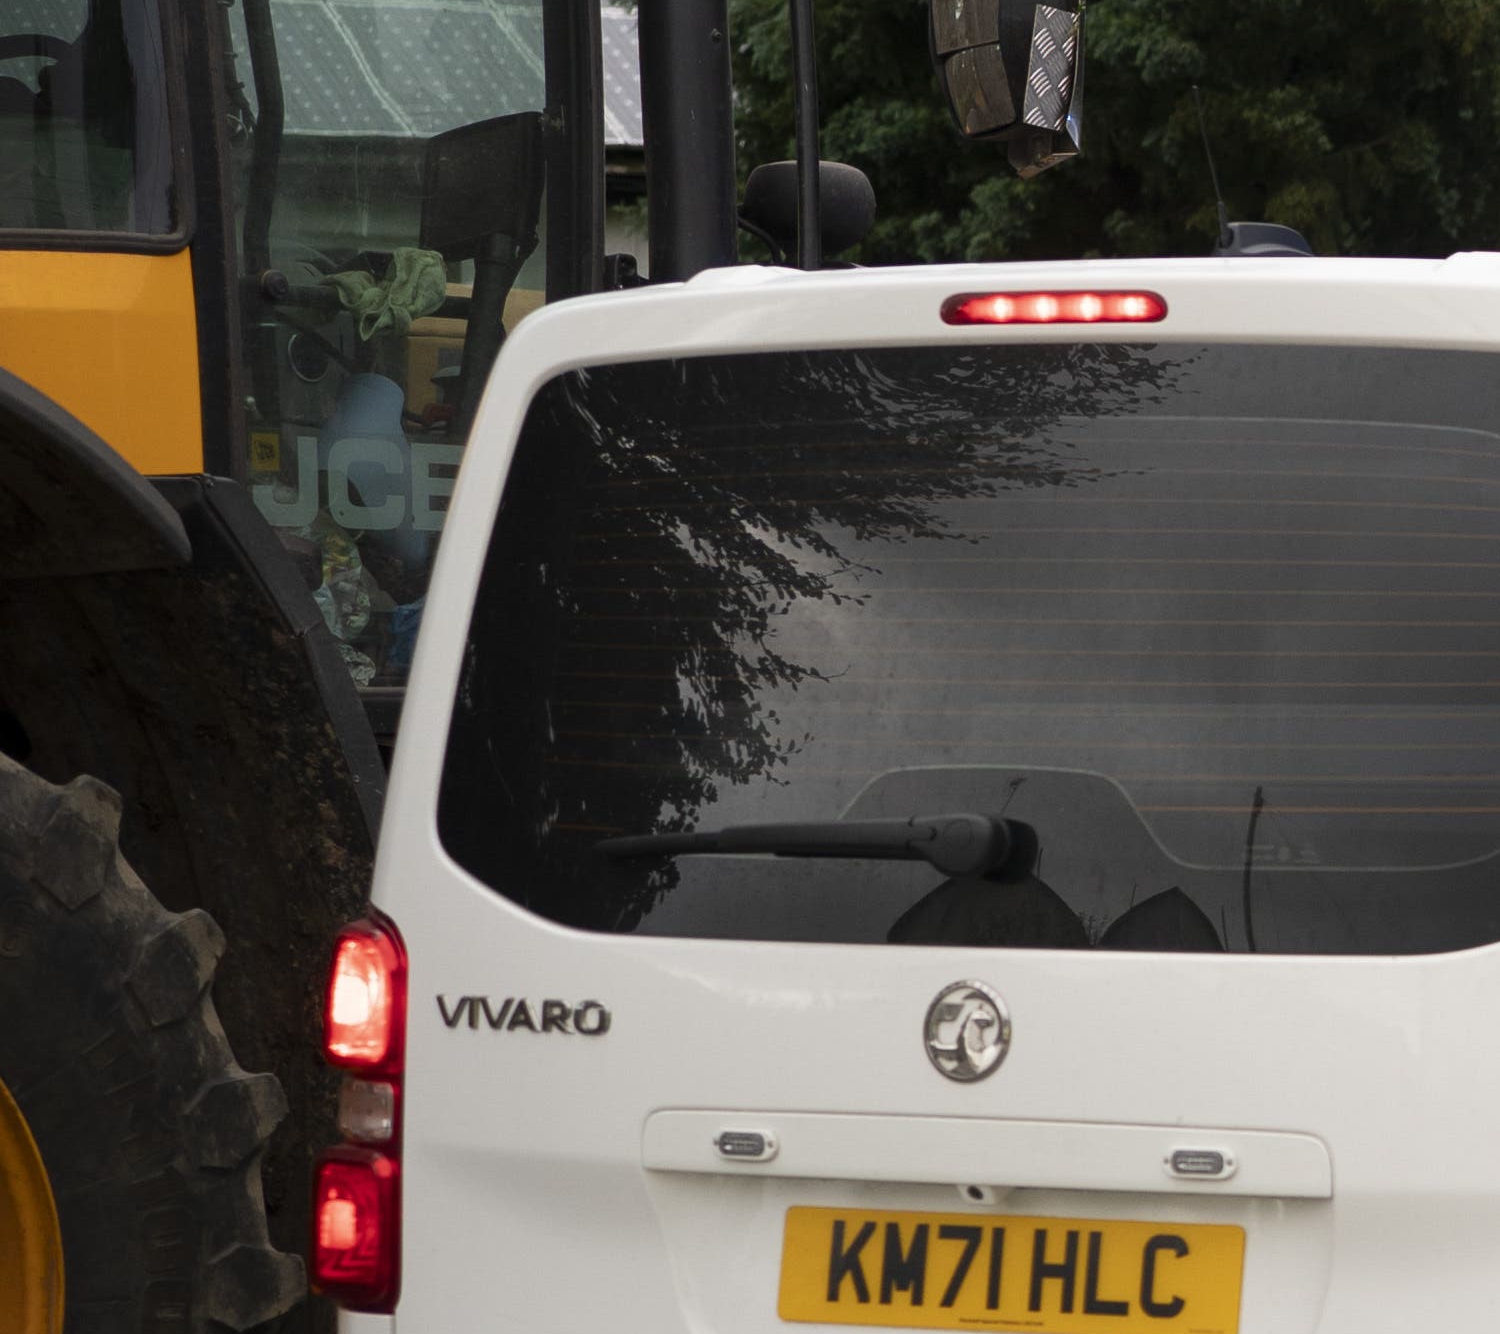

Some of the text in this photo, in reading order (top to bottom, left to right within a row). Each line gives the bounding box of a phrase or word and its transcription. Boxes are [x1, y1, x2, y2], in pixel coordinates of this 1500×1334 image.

[436, 994, 612, 1037] VIVARO
[826, 1218, 1191, 1321] KM71 HLC
